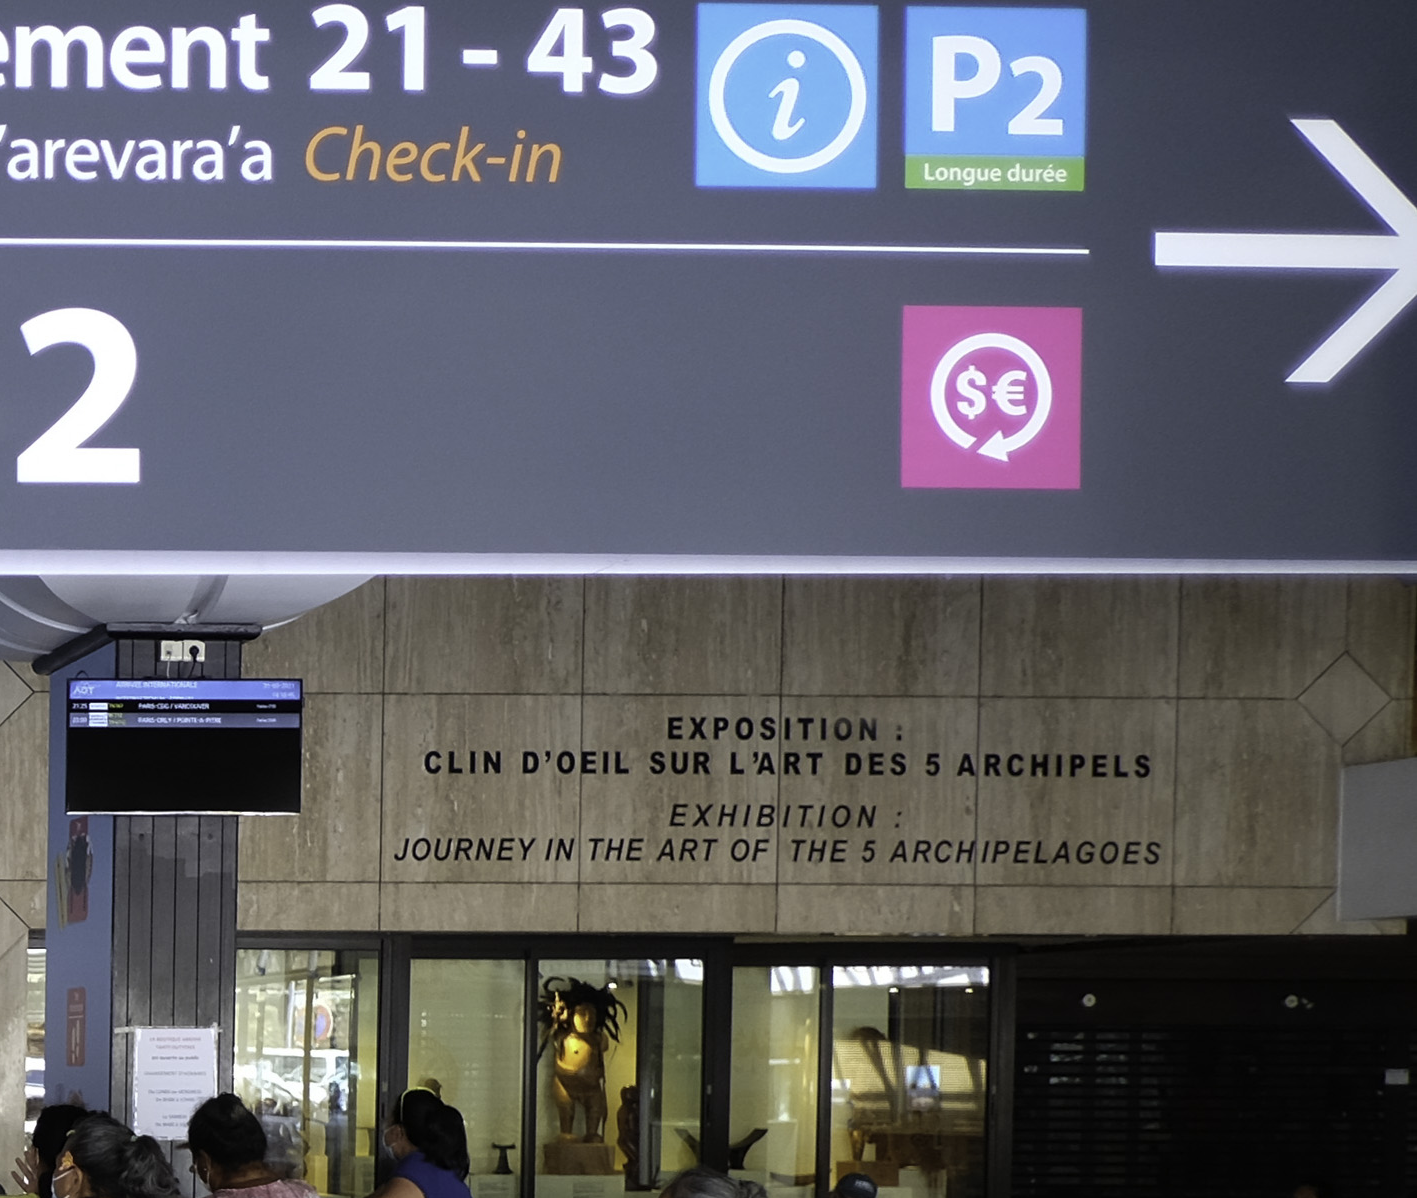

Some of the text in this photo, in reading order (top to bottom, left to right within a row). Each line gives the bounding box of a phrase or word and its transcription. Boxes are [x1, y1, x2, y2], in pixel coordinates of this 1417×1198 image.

[309, 3, 425, 92] 21
[526, 7, 658, 95] 43
[931, 35, 1064, 136] P2
[305, 124, 563, 183] Check-in
[923, 162, 1067, 187] Longue durée
[16, 307, 141, 484] 2
[667, 711, 877, 742] EXPOSITION
[424, 750, 1151, 779] CLIN D’OEIL SUR L’ART DES 5 ARCHIPELS
[669, 799, 877, 829] EXHIBITION
[393, 837, 1161, 865] JOURNEY IN THE ART OF THE 5 ARCHIPELAGOES
